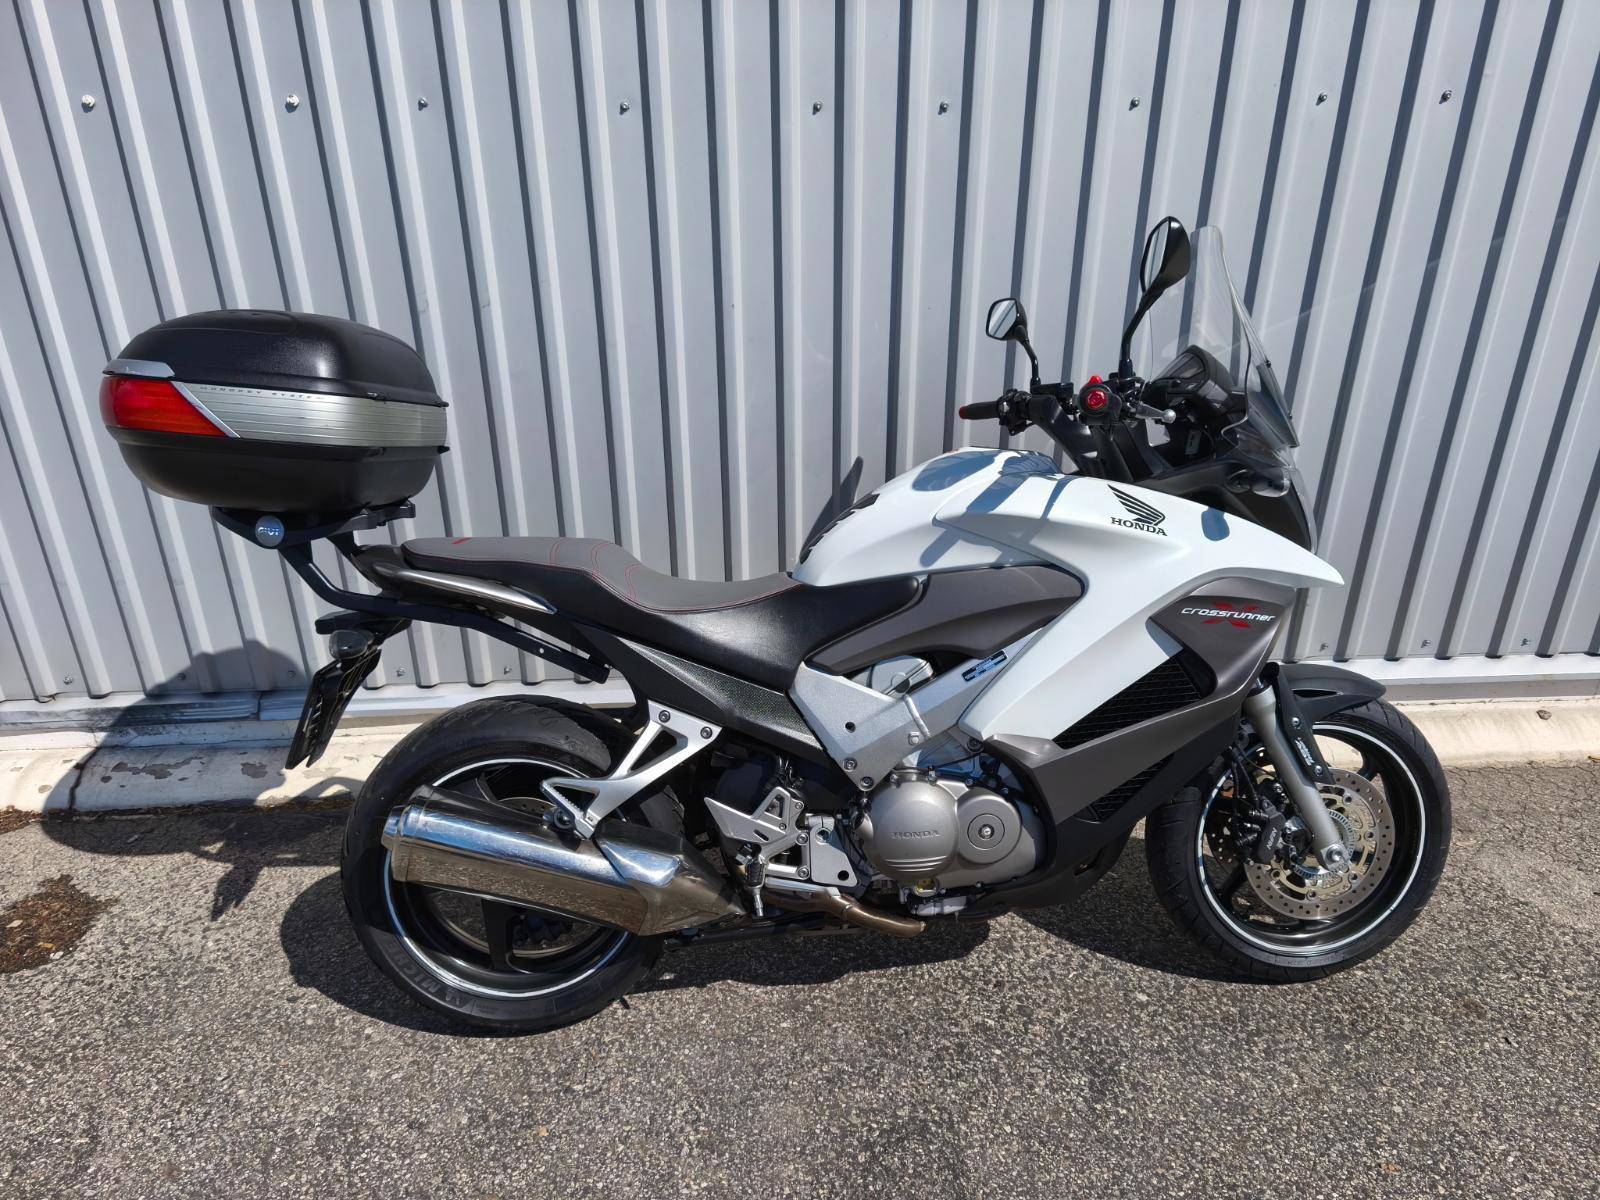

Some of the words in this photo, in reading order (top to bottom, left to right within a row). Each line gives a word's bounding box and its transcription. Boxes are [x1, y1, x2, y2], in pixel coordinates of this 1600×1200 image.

[1110, 516, 1168, 537] HONDA
[1181, 608, 1276, 622] crossrunner
[890, 829, 941, 840] HONDA
